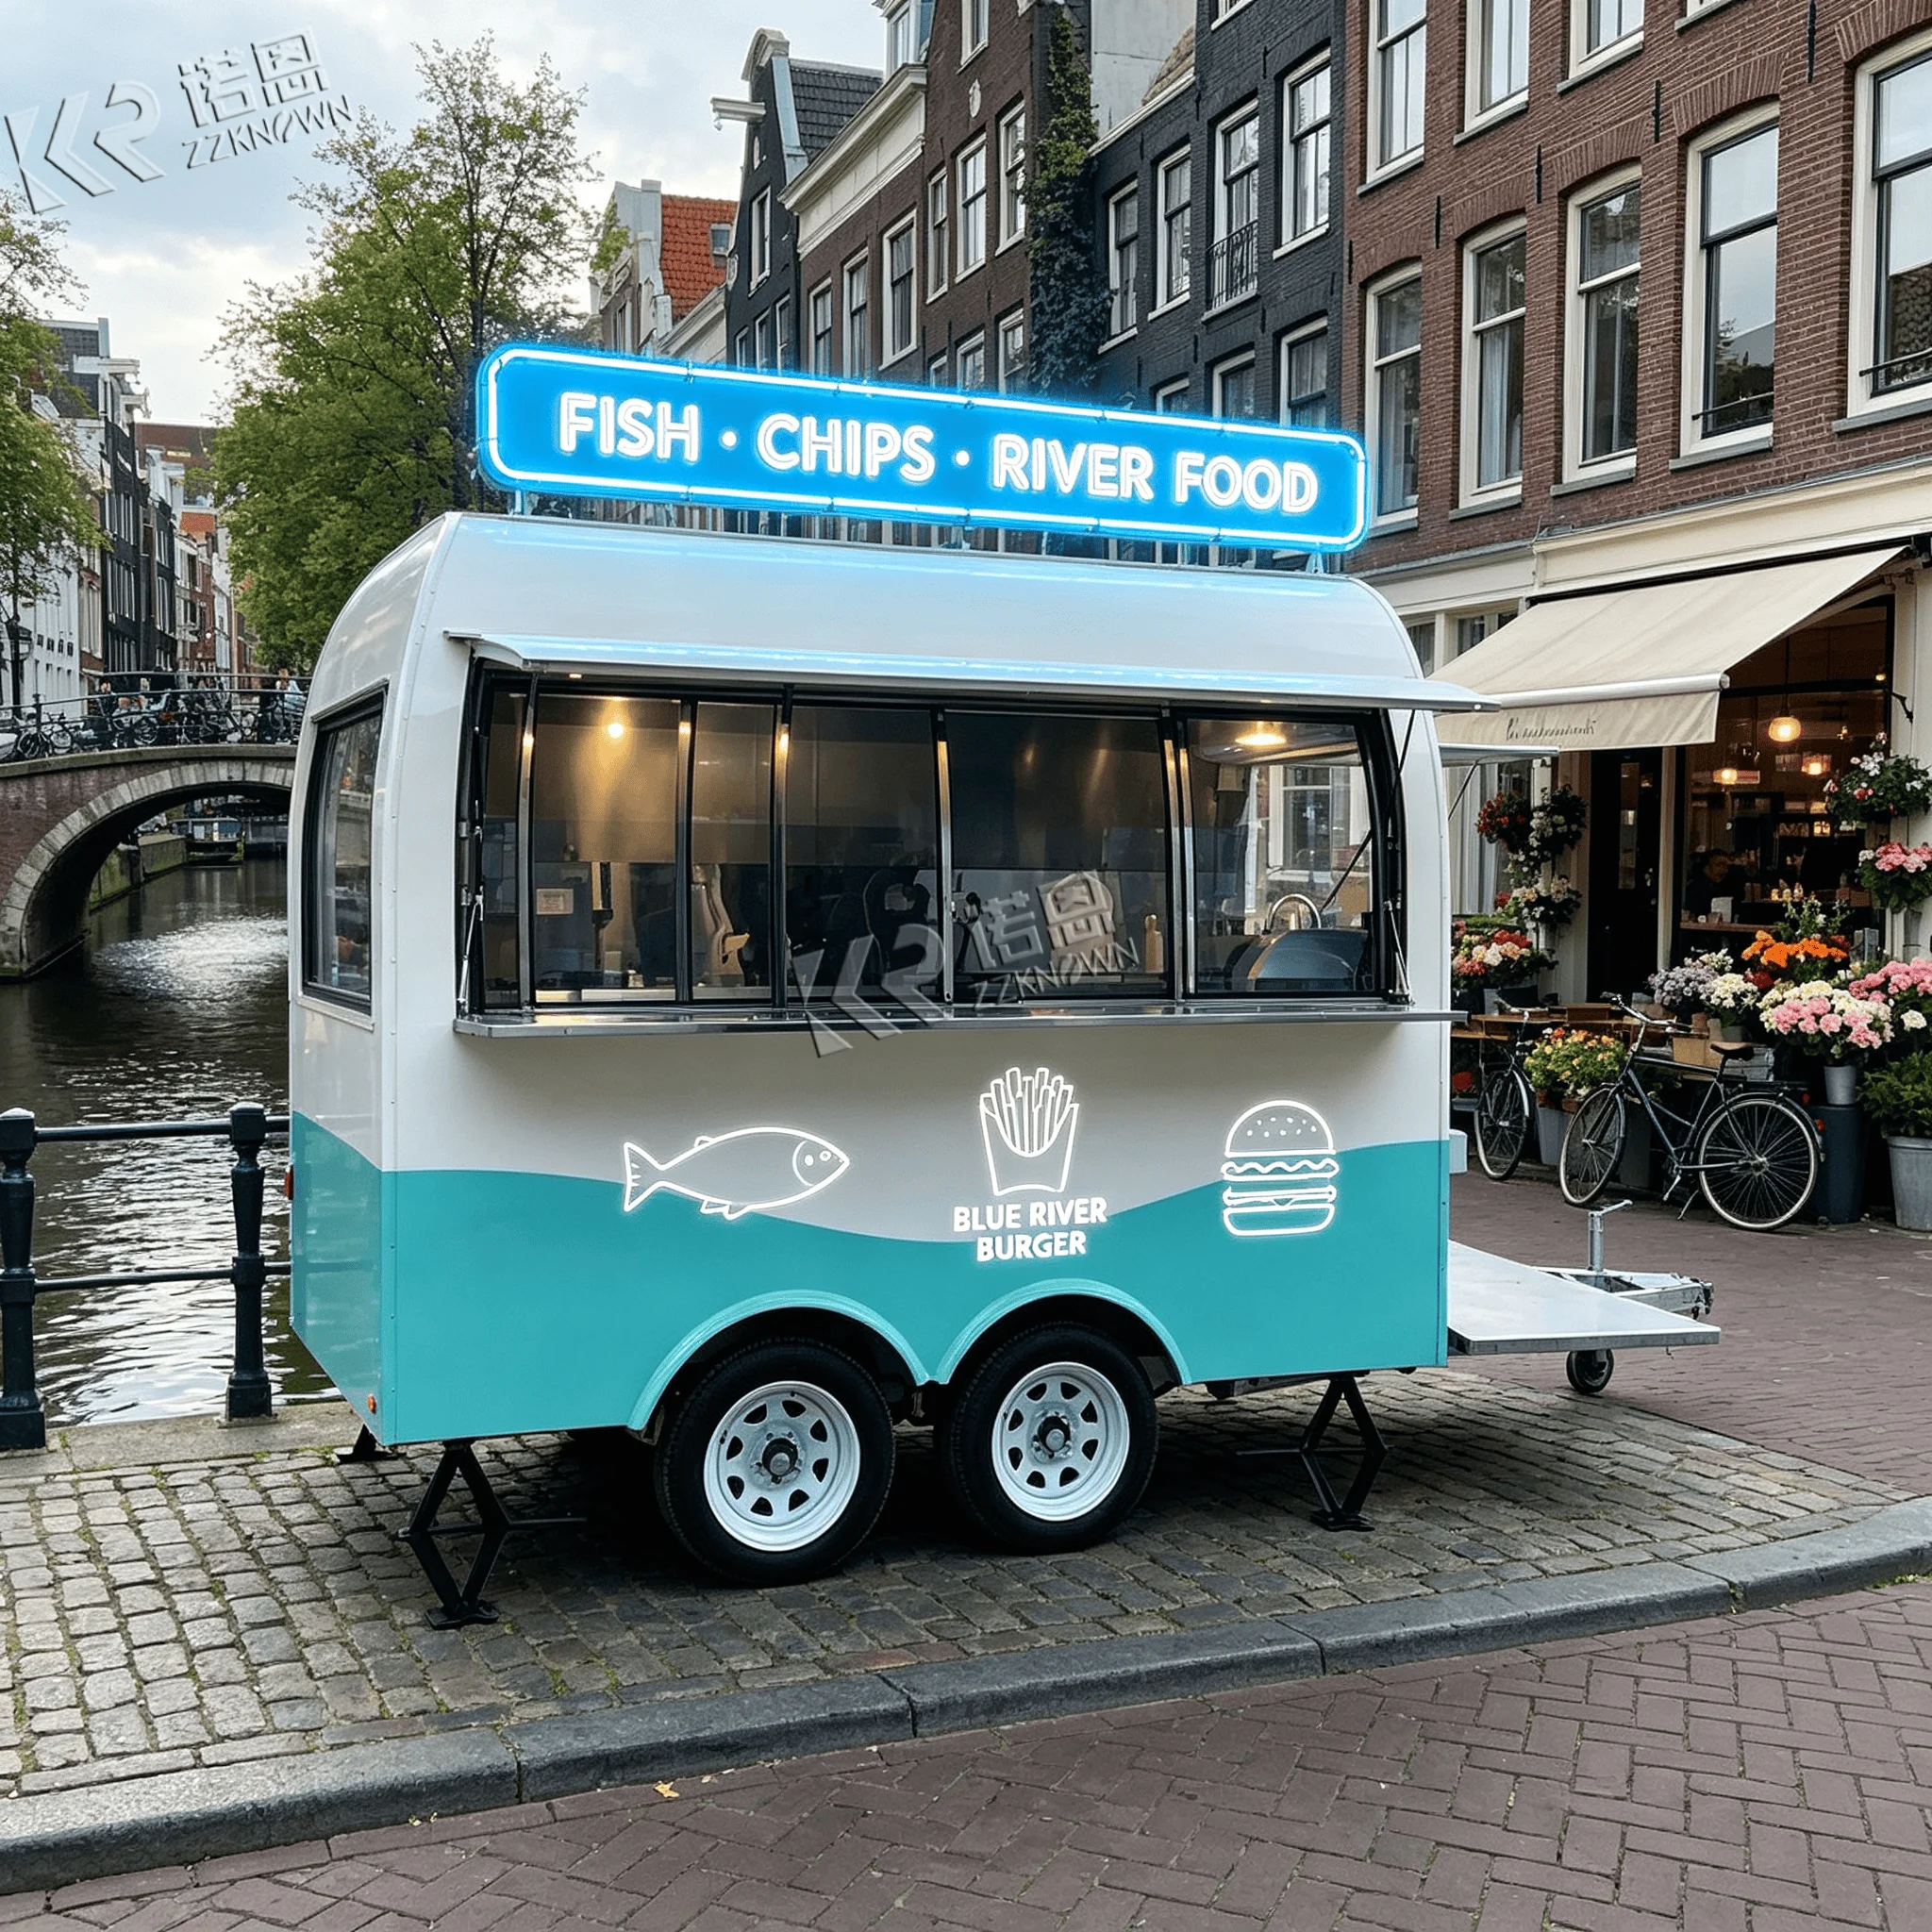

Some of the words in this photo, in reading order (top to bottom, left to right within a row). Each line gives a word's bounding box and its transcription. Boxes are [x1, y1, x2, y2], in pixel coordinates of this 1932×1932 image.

[559, 392, 699, 462] FISH
[757, 413, 936, 482] CHIPS
[992, 434, 1155, 501] RIVER
[1174, 451, 1319, 513] FOOD
[953, 1204, 1022, 1232] BLUE
[1029, 1196, 1108, 1227] RIVER
[976, 1230, 1087, 1262] BURGER
